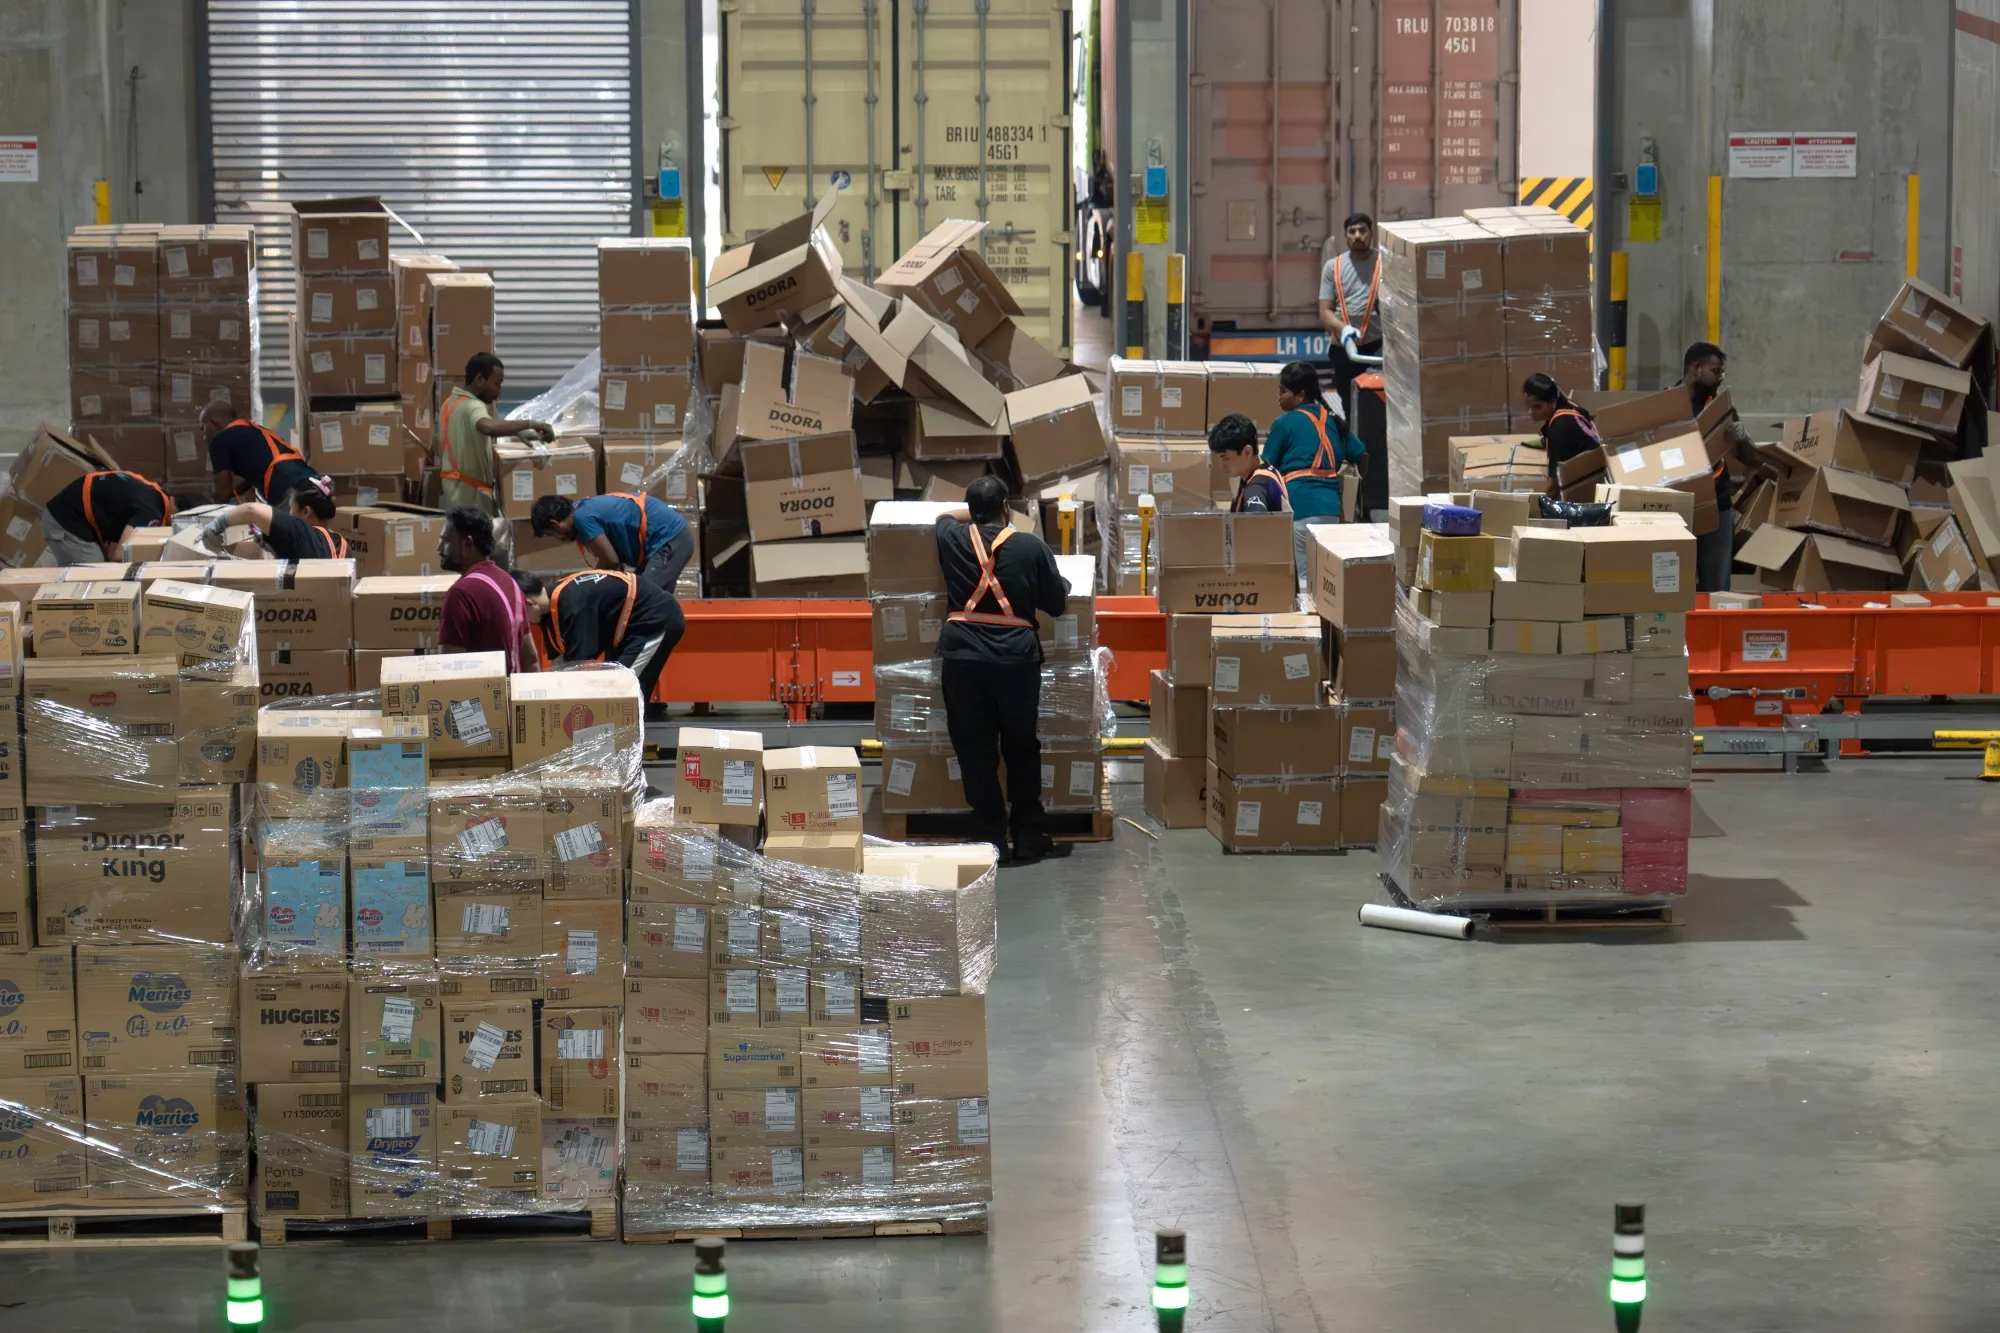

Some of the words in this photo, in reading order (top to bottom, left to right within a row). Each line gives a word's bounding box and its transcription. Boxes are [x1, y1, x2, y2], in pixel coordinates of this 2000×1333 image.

[1396, 18, 1428, 34] TRLU
[1446, 16, 1494, 32] 703818
[1444, 38, 1476, 52] 45G1
[946, 126, 979, 142] BRIU
[986, 126, 1034, 142] 488334
[988, 144, 1019, 160] 45G1
[936, 186, 956, 201] TARE
[746, 276, 797, 306] DOORA
[1276, 336, 1297, 354] LH
[768, 410, 823, 430] DOORA
[780, 496, 834, 513] DOORA
[352, 539, 368, 554] ORA
[1194, 592, 1258, 607] DOORA
[390, 608, 441, 621] DOOR
[260, 682, 313, 696] OORA
[808, 820, 838, 828] Shopee
[92, 832, 184, 857] Diaper
[103, 858, 166, 882] King
[128, 987, 192, 1002] Merries
[260, 1008, 340, 1024] HUGGIES
[300, 1028, 340, 1038] AirSoft
[724, 1052, 786, 1062] Supermarket
[136, 1109, 200, 1128] Merries
[374, 1138, 414, 1151] Drypers
[265, 1166, 304, 1177] Pants
[265, 1180, 292, 1188] Value
